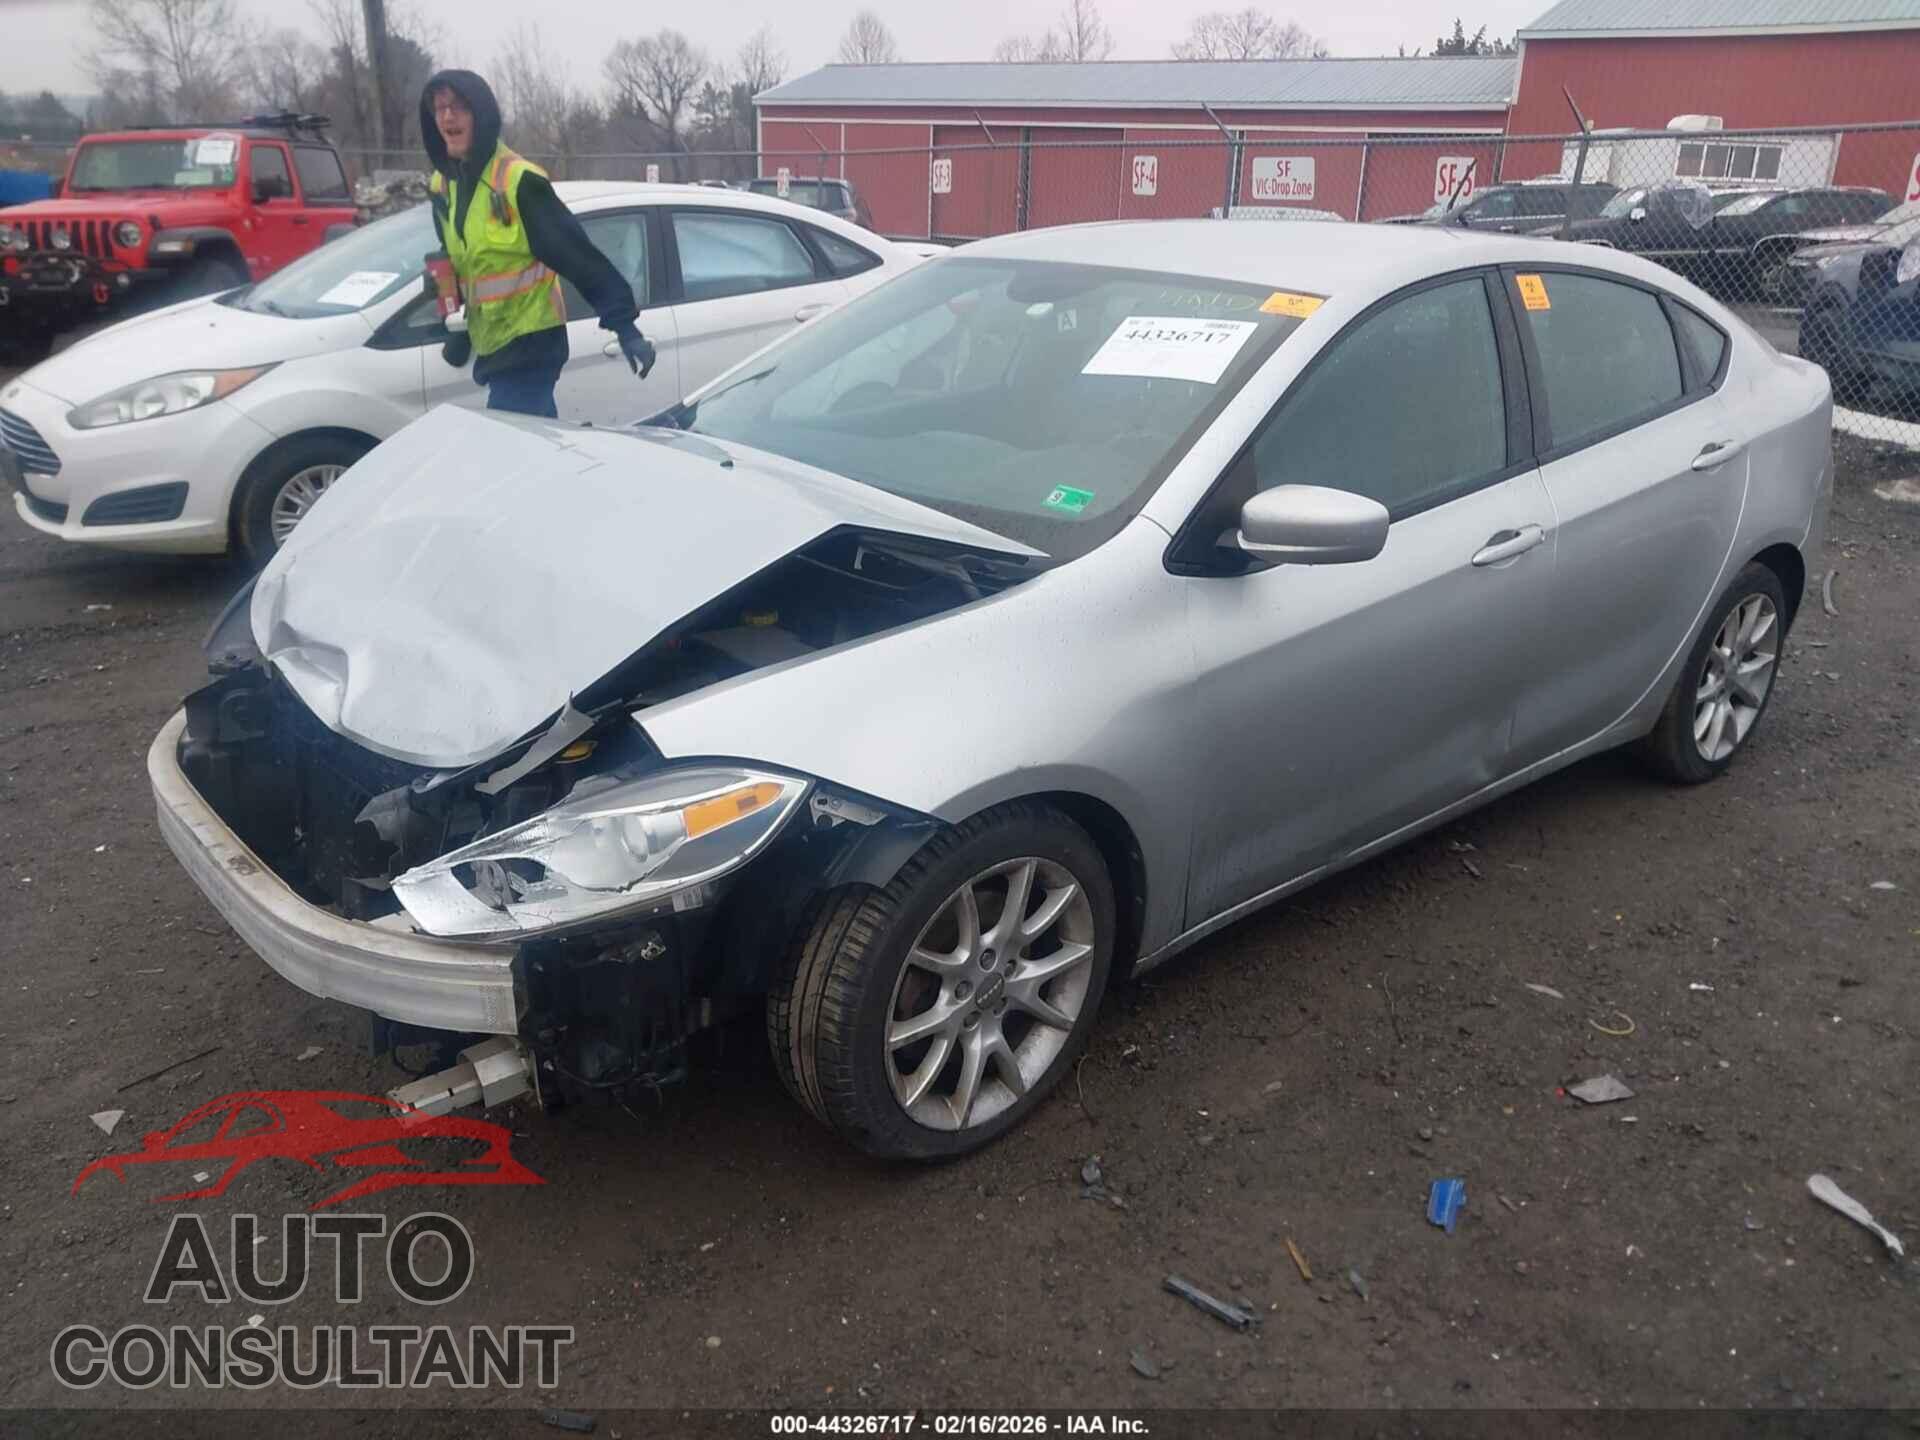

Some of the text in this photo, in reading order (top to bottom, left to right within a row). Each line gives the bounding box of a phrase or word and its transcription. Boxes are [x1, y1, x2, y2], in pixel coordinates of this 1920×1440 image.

[1277, 160, 1291, 177] SF
[1292, 178, 1313, 195] Zone
[1124, 329, 1232, 343] 44326717
